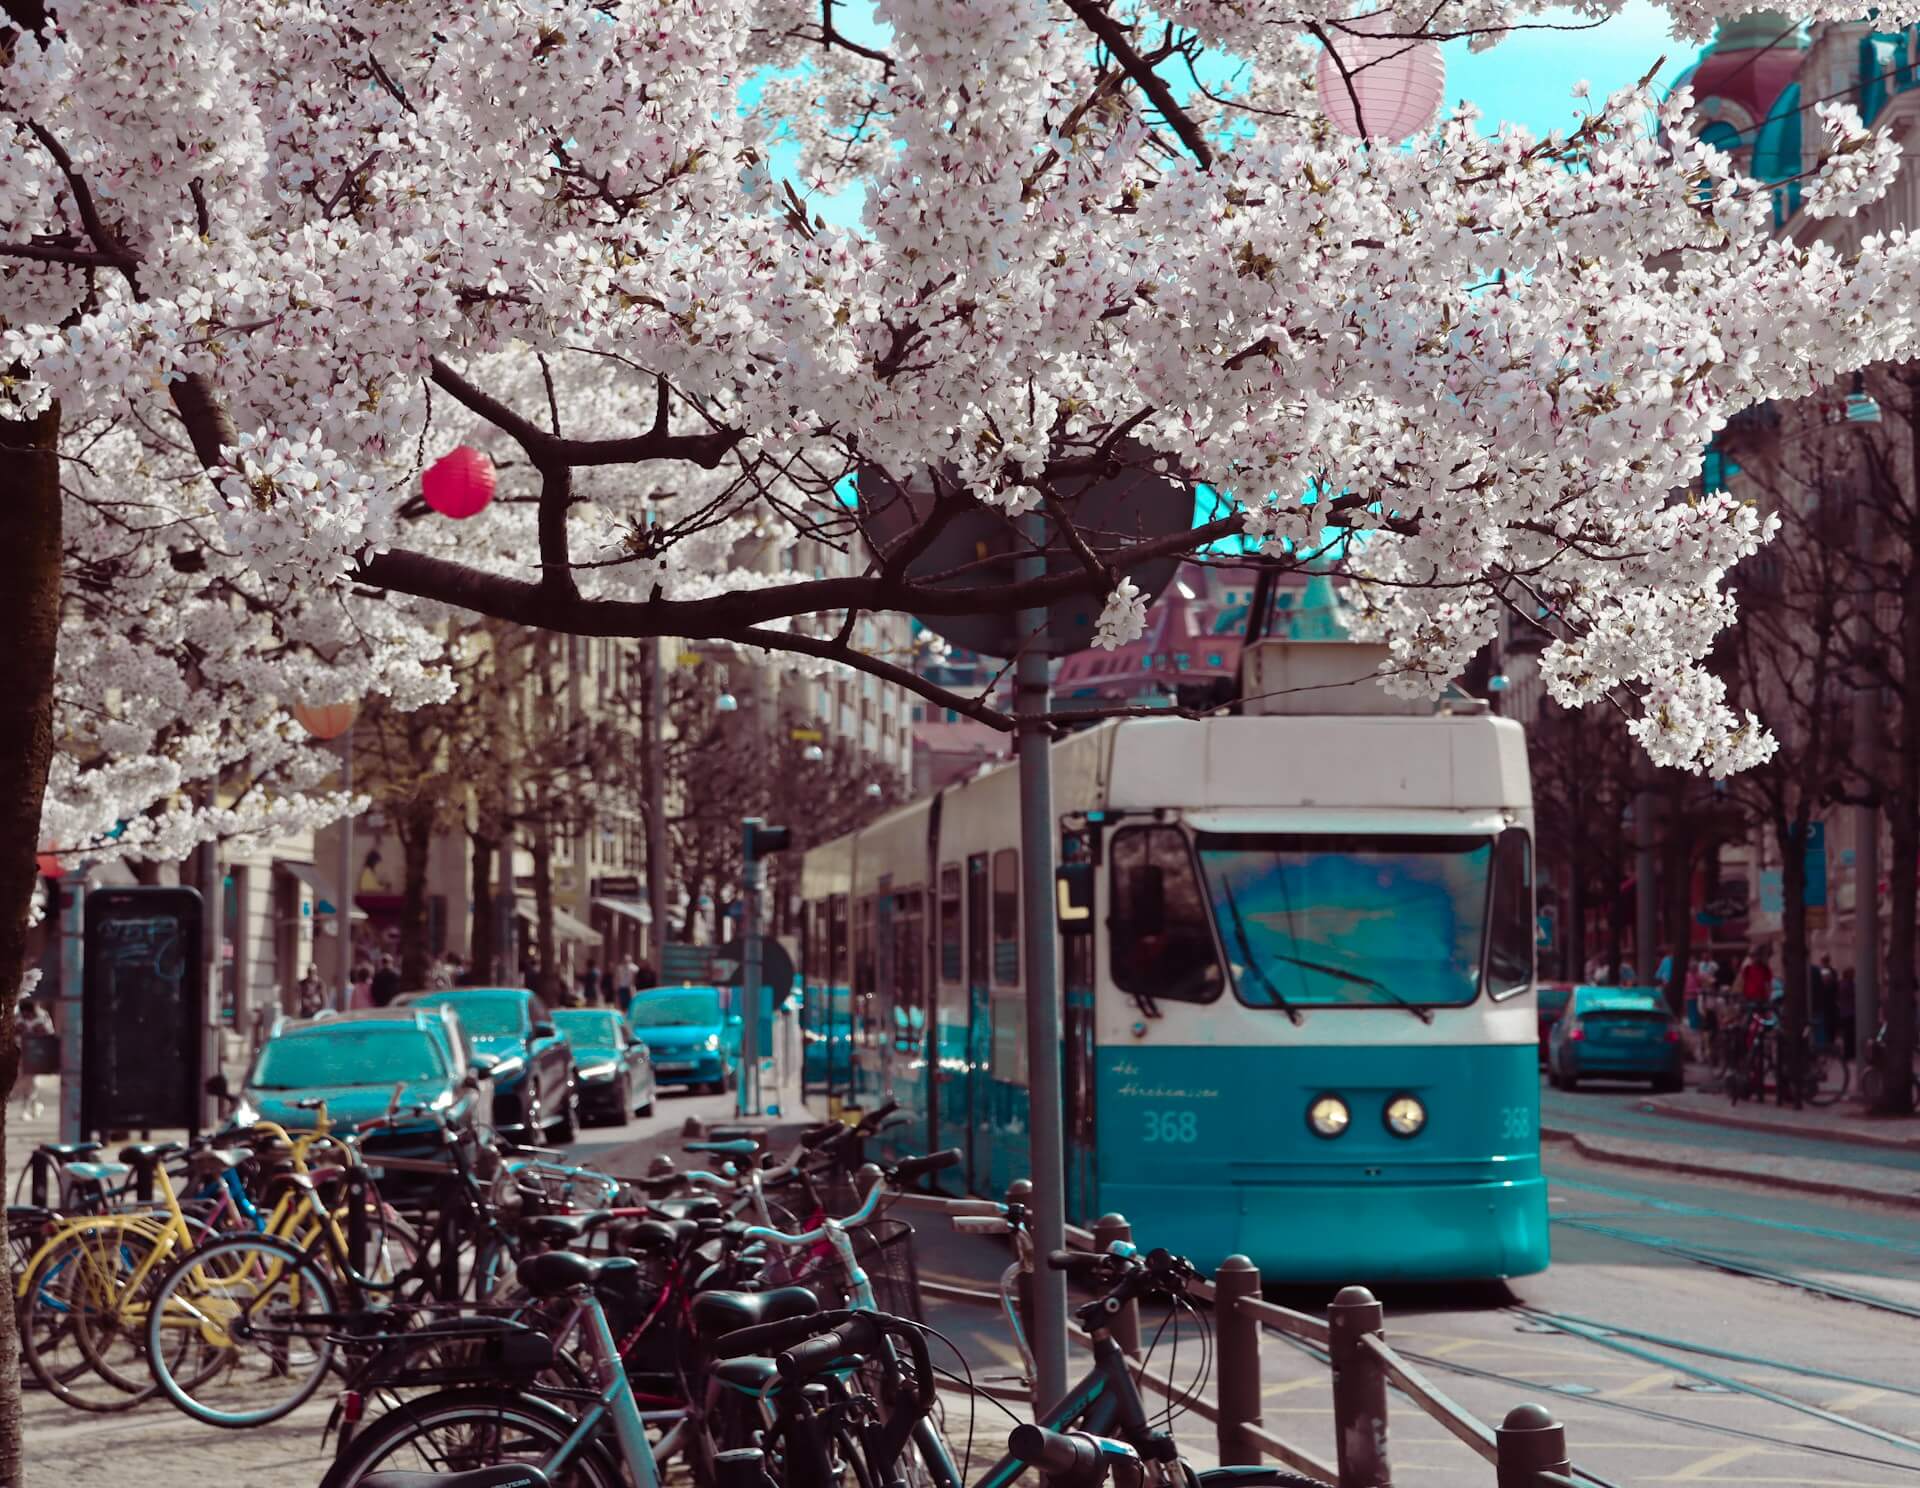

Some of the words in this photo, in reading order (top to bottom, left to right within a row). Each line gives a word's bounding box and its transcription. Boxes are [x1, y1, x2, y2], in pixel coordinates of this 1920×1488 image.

[1058, 879, 1089, 919] L
[1142, 1111, 1198, 1143] 368
[1501, 1107, 1529, 1139] 368
